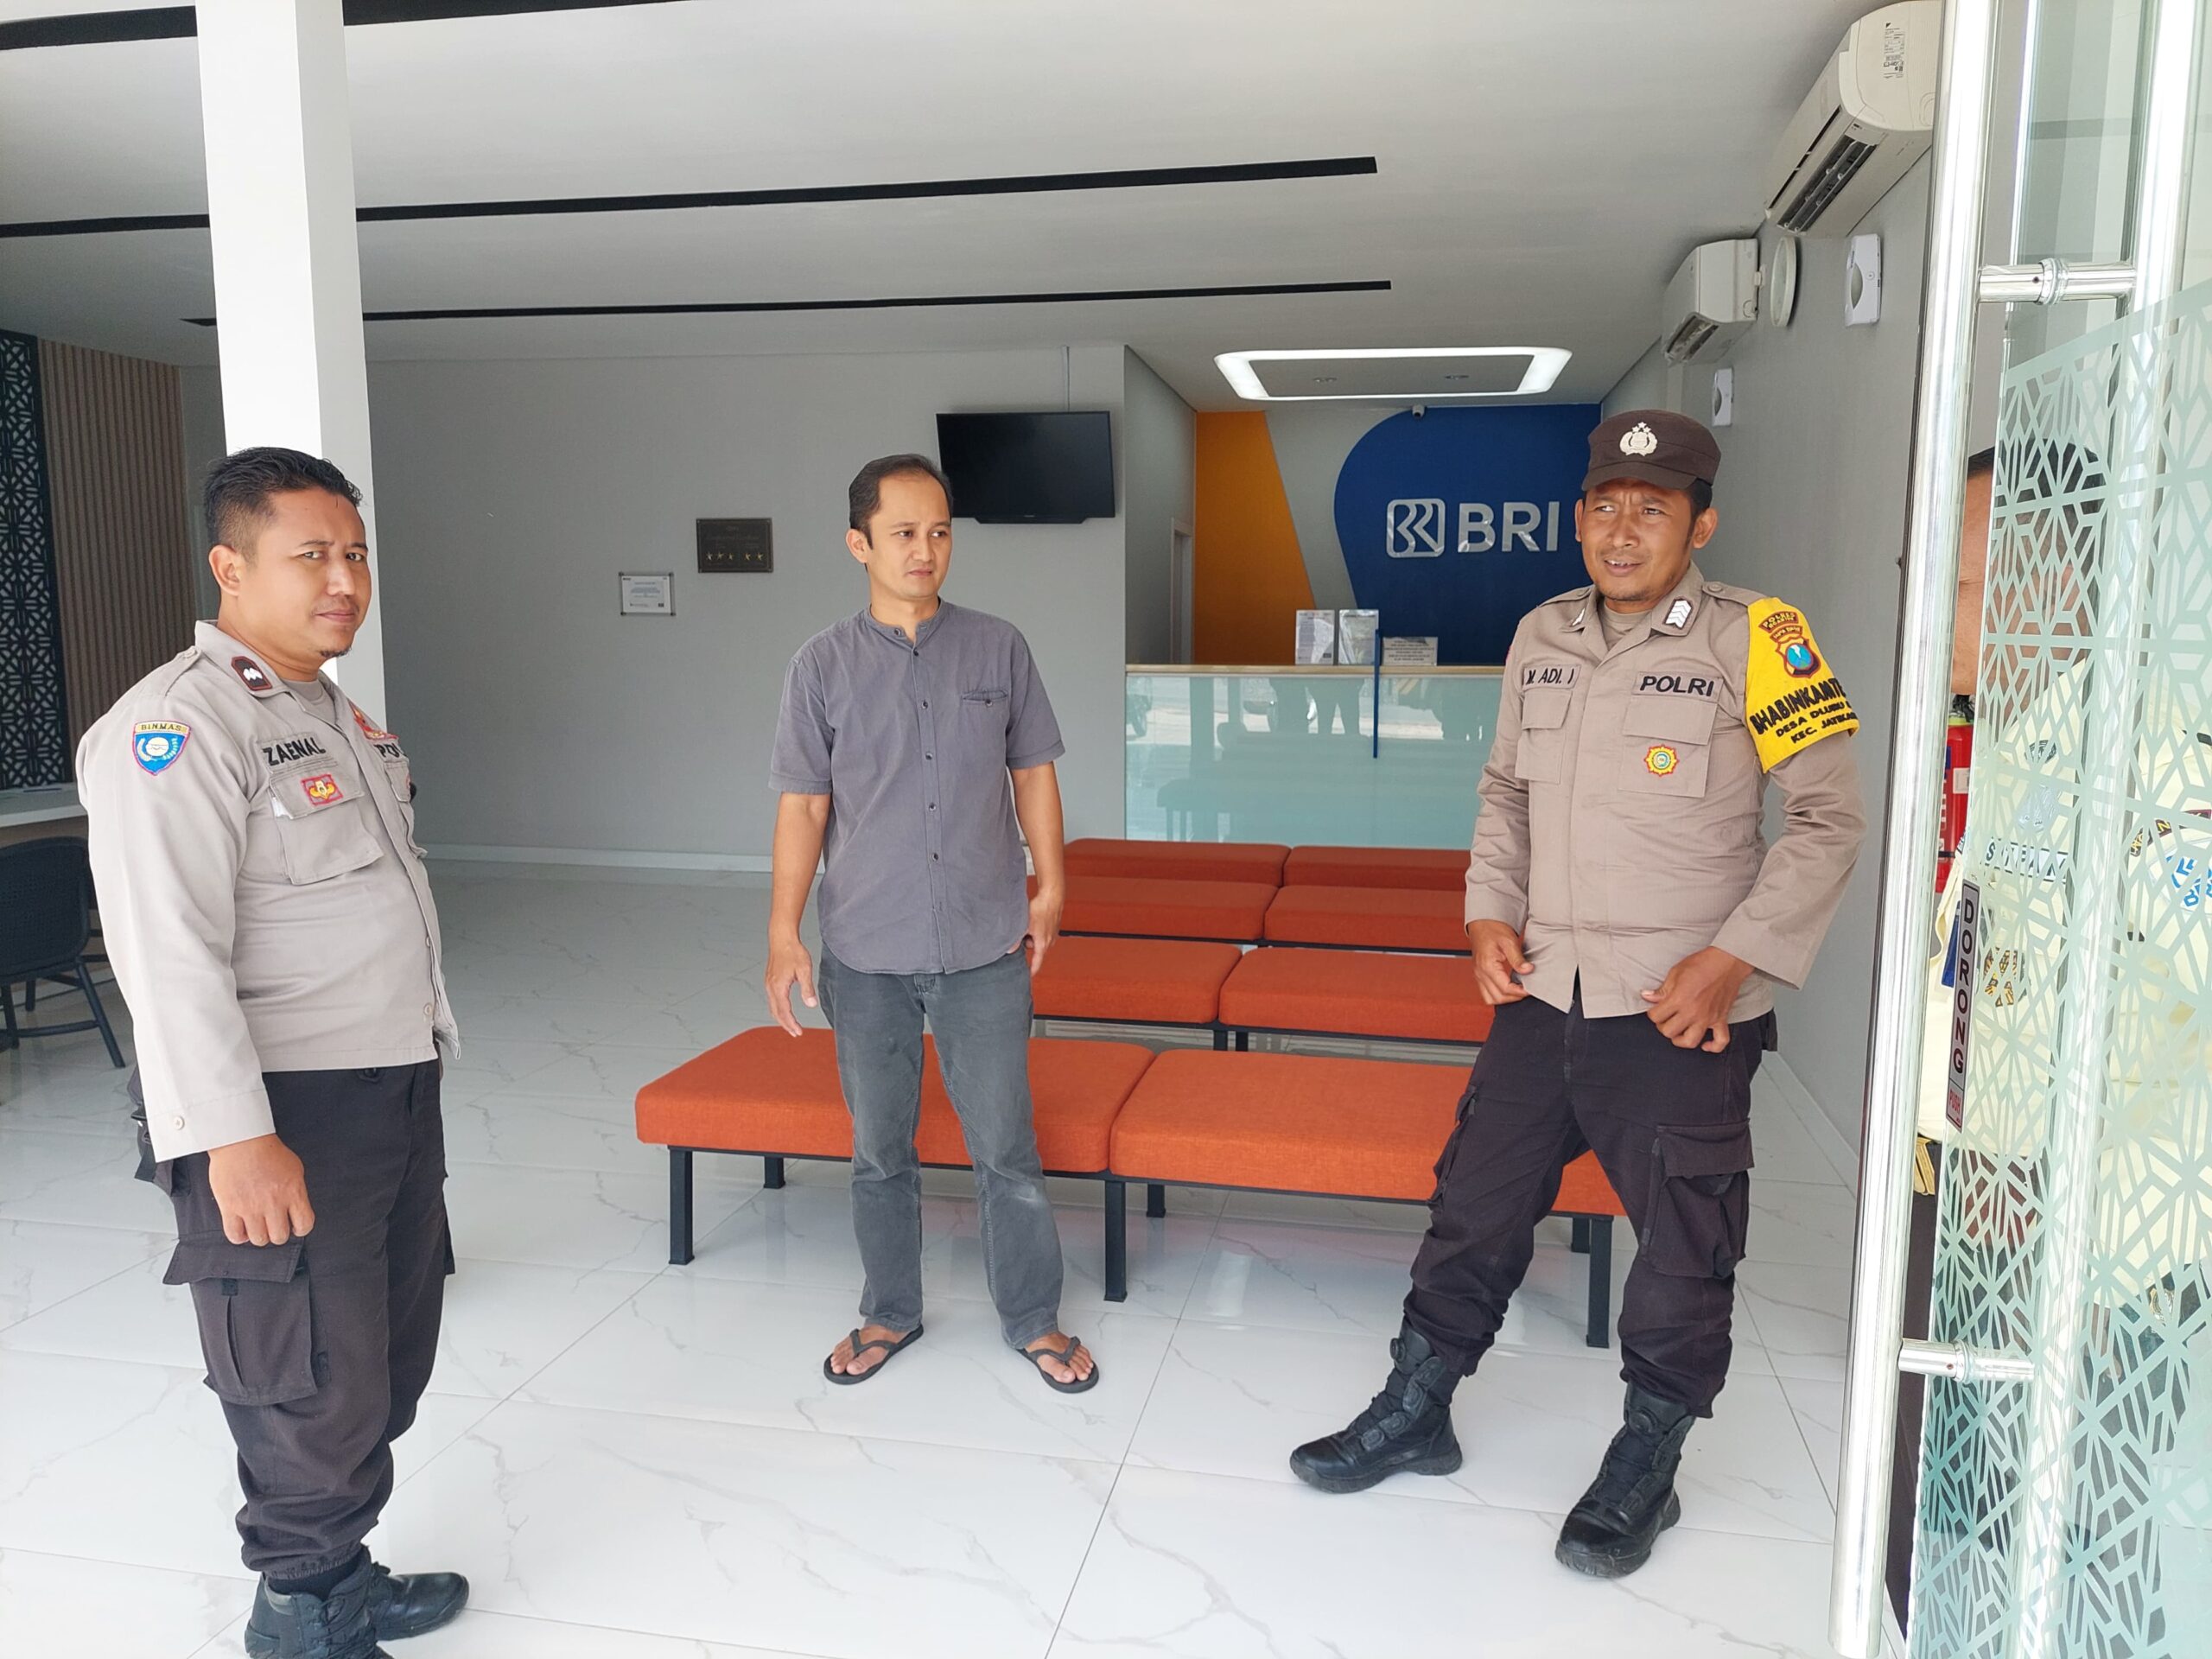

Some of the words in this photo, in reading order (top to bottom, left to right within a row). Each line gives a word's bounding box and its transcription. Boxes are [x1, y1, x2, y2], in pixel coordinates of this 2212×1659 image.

[1457, 500, 1560, 553] BRI
[1639, 676, 1714, 696] POLRI
[141, 722, 182, 732] BINMAS
[1776, 716, 1808, 737] DESA
[1790, 727, 1818, 744] KEC.
[262, 737, 327, 766] ZAENAL
[1953, 898, 1974, 1075] DORONG
